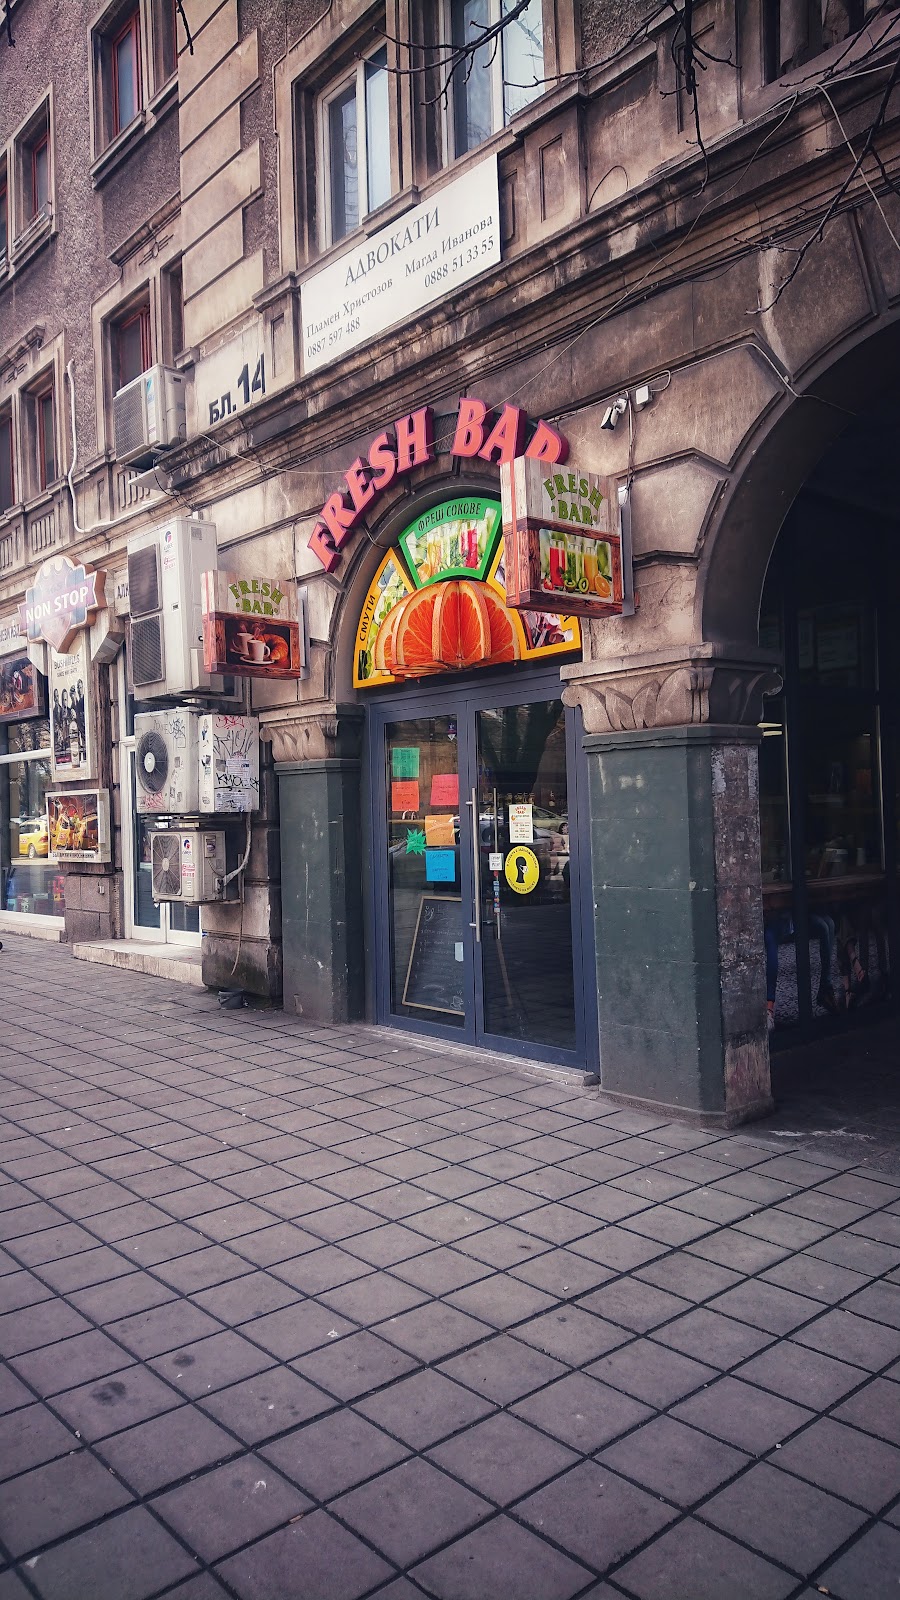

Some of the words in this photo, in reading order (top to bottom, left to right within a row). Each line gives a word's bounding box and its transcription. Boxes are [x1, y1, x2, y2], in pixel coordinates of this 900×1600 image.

[344, 206, 440, 287] АДВОКАТИ
[404, 251, 438, 277] Магда
[442, 216, 493, 254] Иванова
[424, 264, 449, 288] 0888
[306, 312, 340, 338] Пламен
[342, 278, 393, 316] Христозов
[307, 338, 326, 358] 0887
[328, 328, 343, 346] 597
[345, 316, 361, 335] 488
[209, 391, 236, 426] БЛ.
[238, 352, 266, 404] 14
[307, 406, 434, 574] FRESH
[543, 474, 604, 511] FRESH
[418, 508, 444, 532] ФРЕШ
[446, 502, 481, 518] СОКОВЕ
[26, 600, 51, 623] NON
[54, 586, 88, 615] STOP
[229, 580, 284, 605] FRESH
[360, 594, 376, 642] СМУТИ
